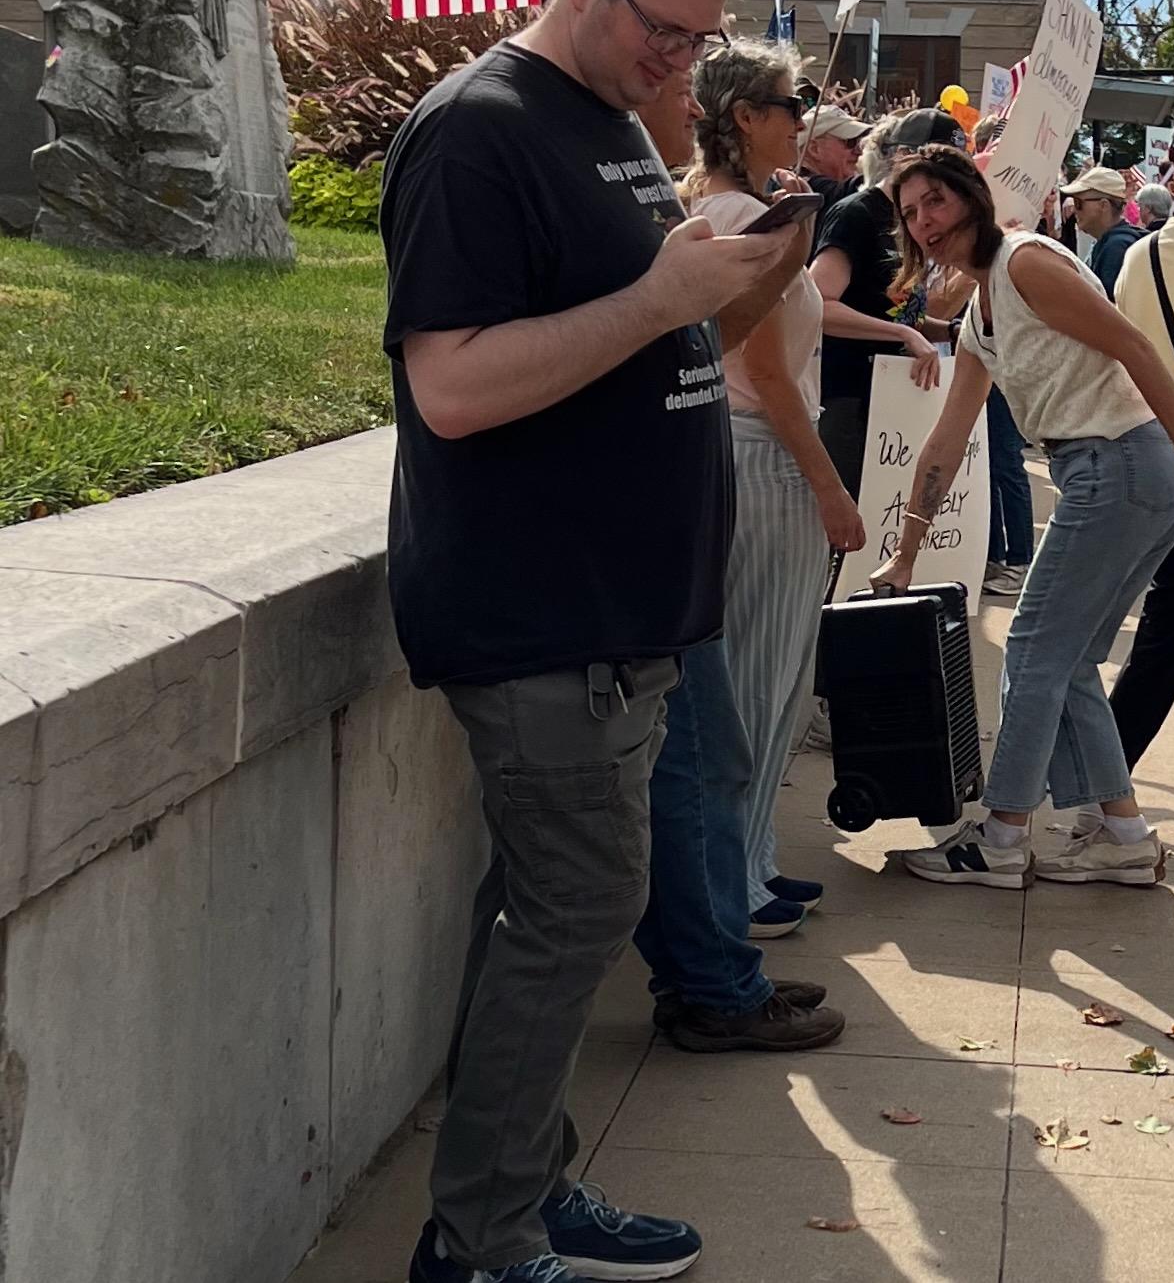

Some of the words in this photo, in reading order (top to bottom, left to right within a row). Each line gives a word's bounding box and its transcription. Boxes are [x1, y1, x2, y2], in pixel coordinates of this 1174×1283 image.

[879, 430, 914, 467] We
[881, 490, 970, 527] ABLY
[880, 528, 962, 562] RUIRED
